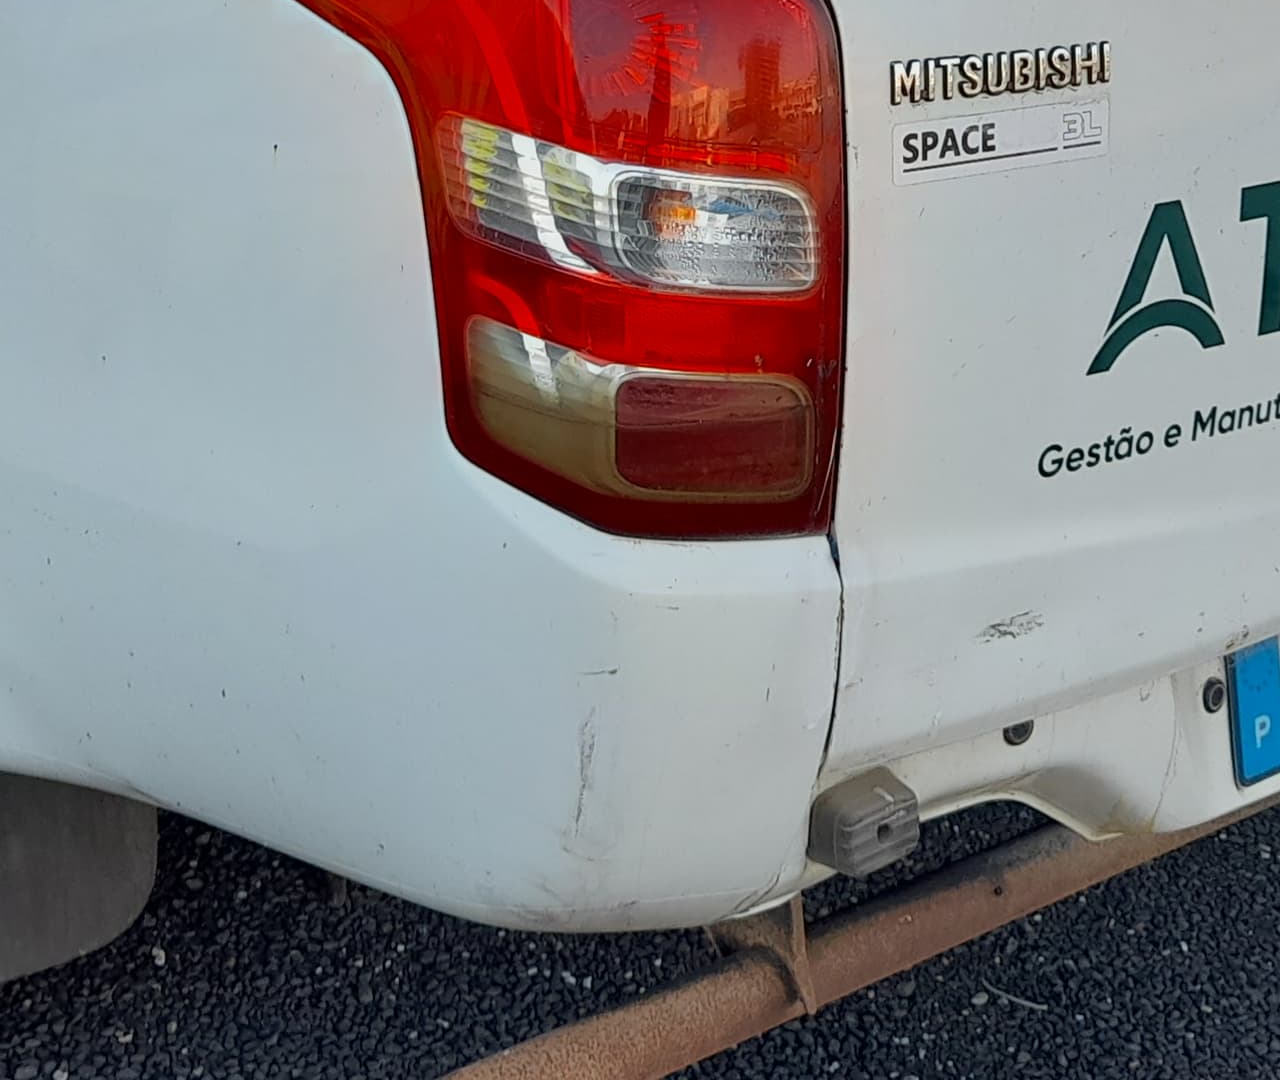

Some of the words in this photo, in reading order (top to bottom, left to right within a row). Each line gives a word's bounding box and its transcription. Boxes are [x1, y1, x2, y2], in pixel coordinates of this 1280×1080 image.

[889, 40, 1112, 107] MITSUBISHI
[901, 122, 997, 164] SPACE
[1037, 426, 1154, 478] Gestão
[1163, 422, 1182, 448] e
[1254, 714, 1271, 749] P
